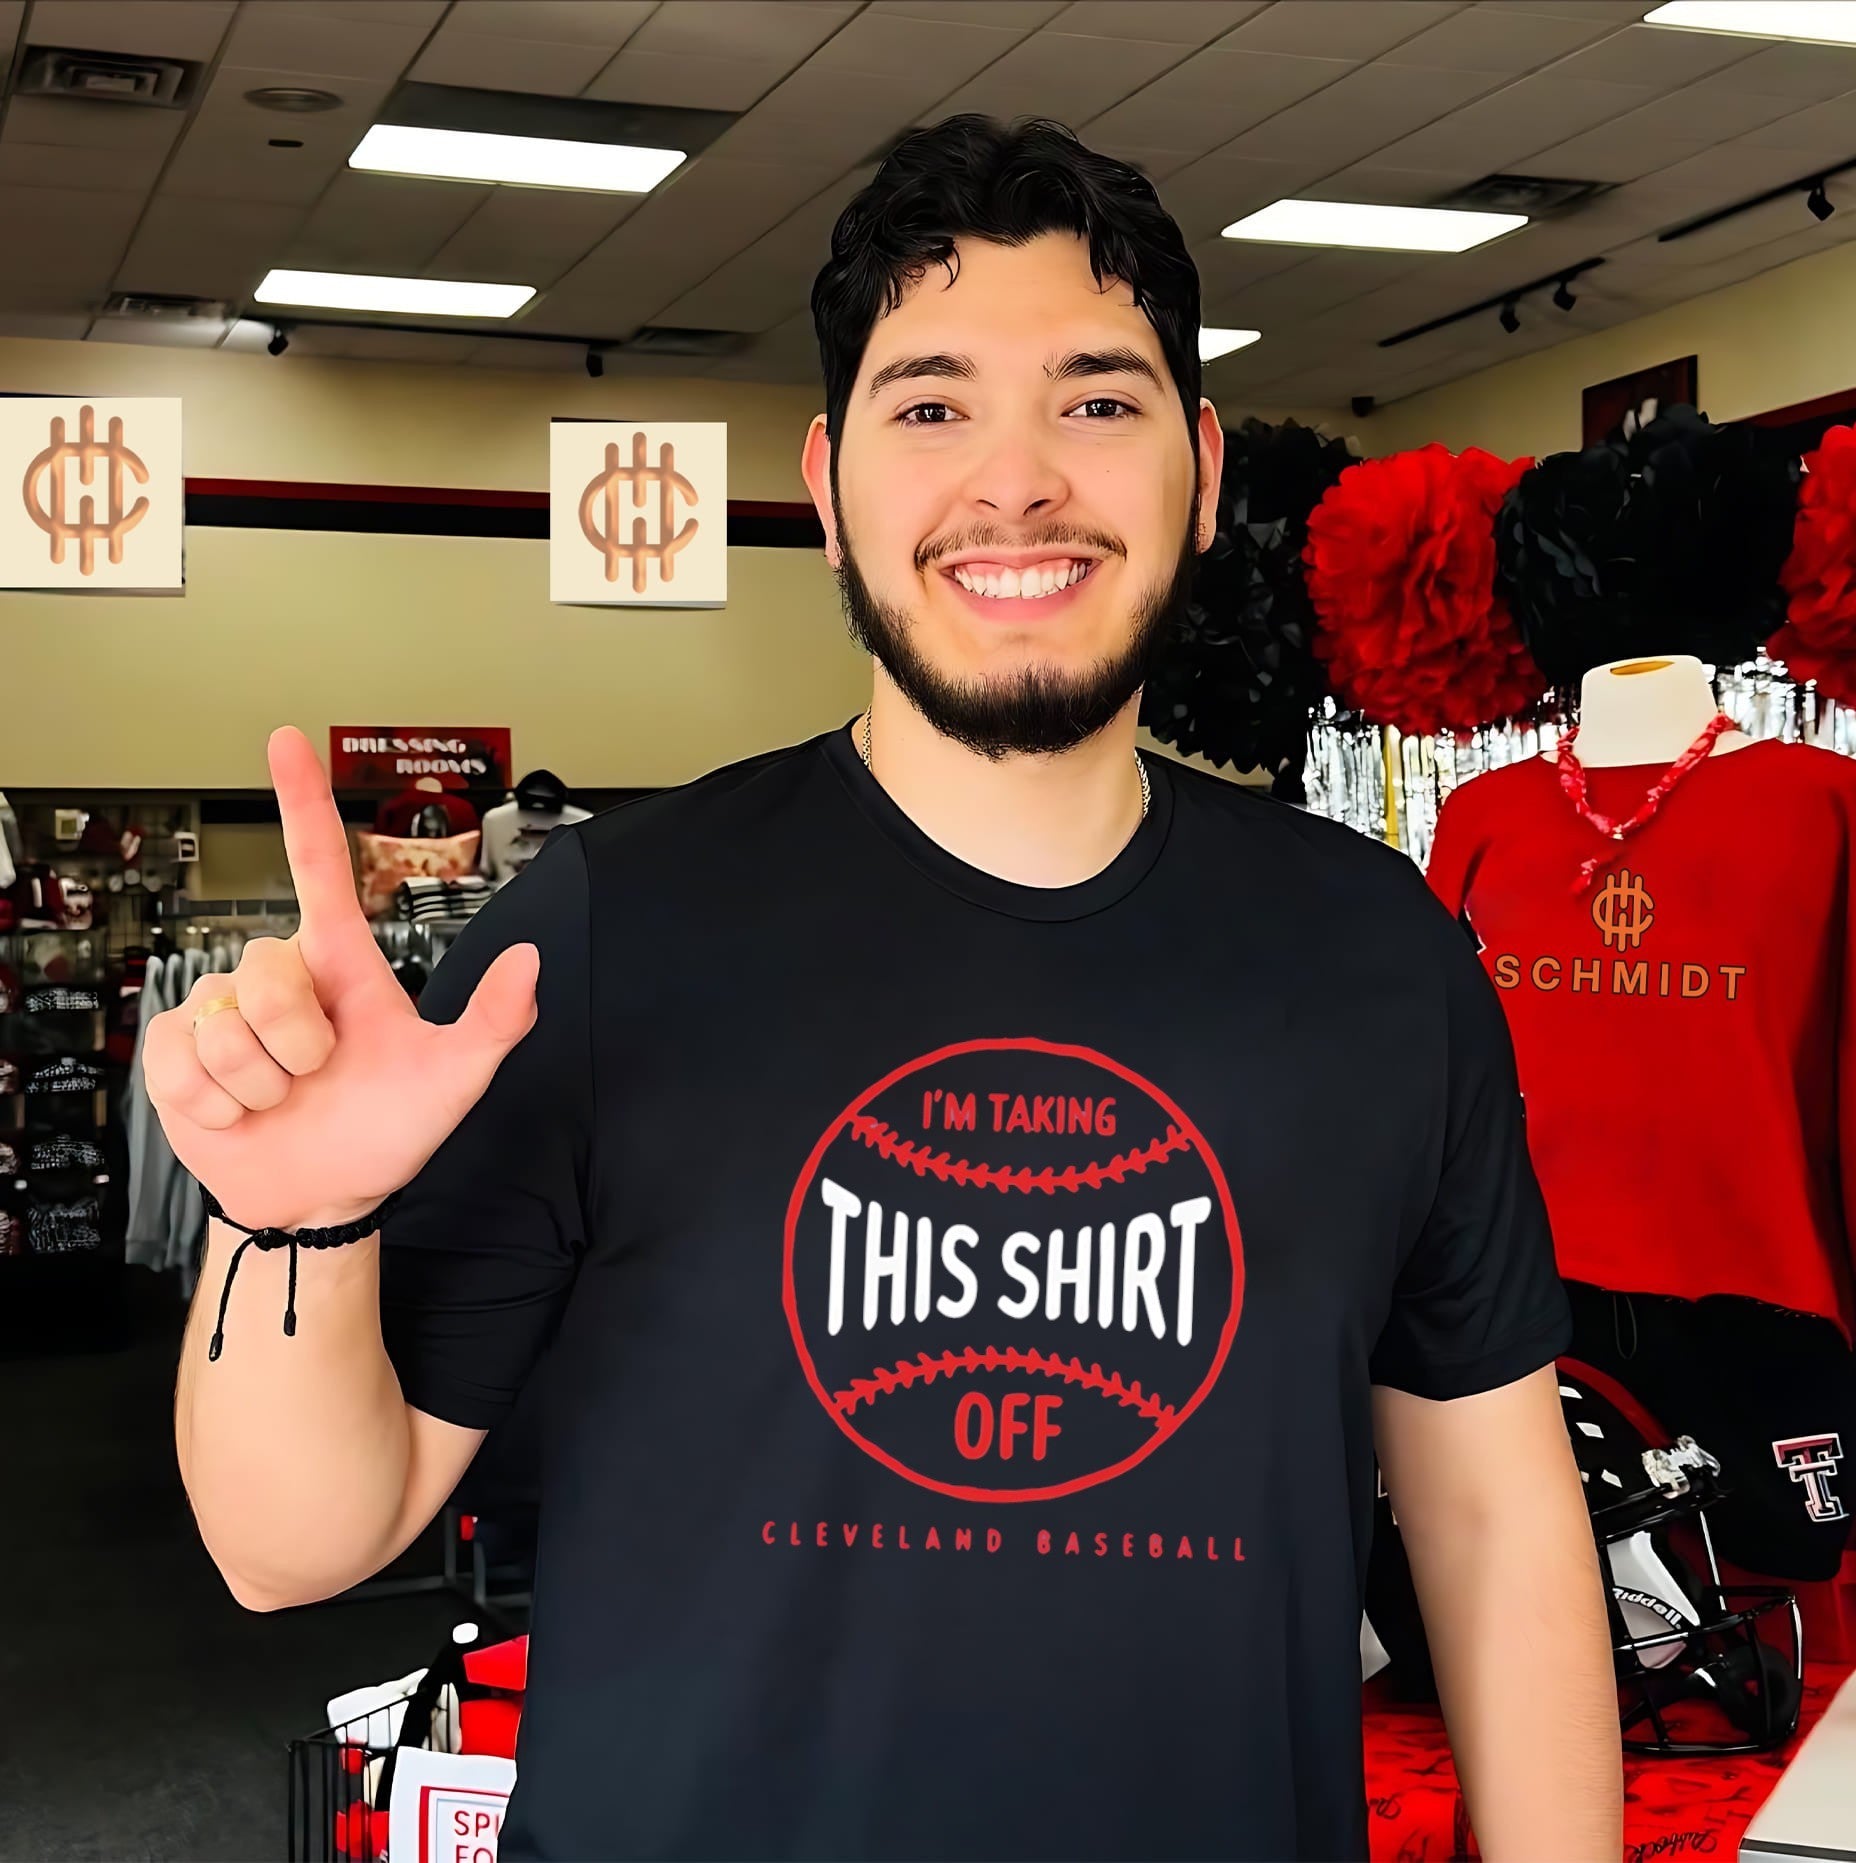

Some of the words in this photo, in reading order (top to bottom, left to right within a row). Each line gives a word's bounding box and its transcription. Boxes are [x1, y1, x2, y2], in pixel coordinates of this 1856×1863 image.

[1494, 953, 1747, 1000] SCHMIDT
[922, 1089, 977, 1132] I'M
[987, 1092, 1117, 1137] TAKING
[821, 1177, 980, 1337] THIS
[996, 1195, 1212, 1347] SHIRT
[953, 1391, 1064, 1462] OFF
[761, 1520, 1002, 1553] CLEVELAND
[1036, 1529, 1246, 1562] BASEBALL
